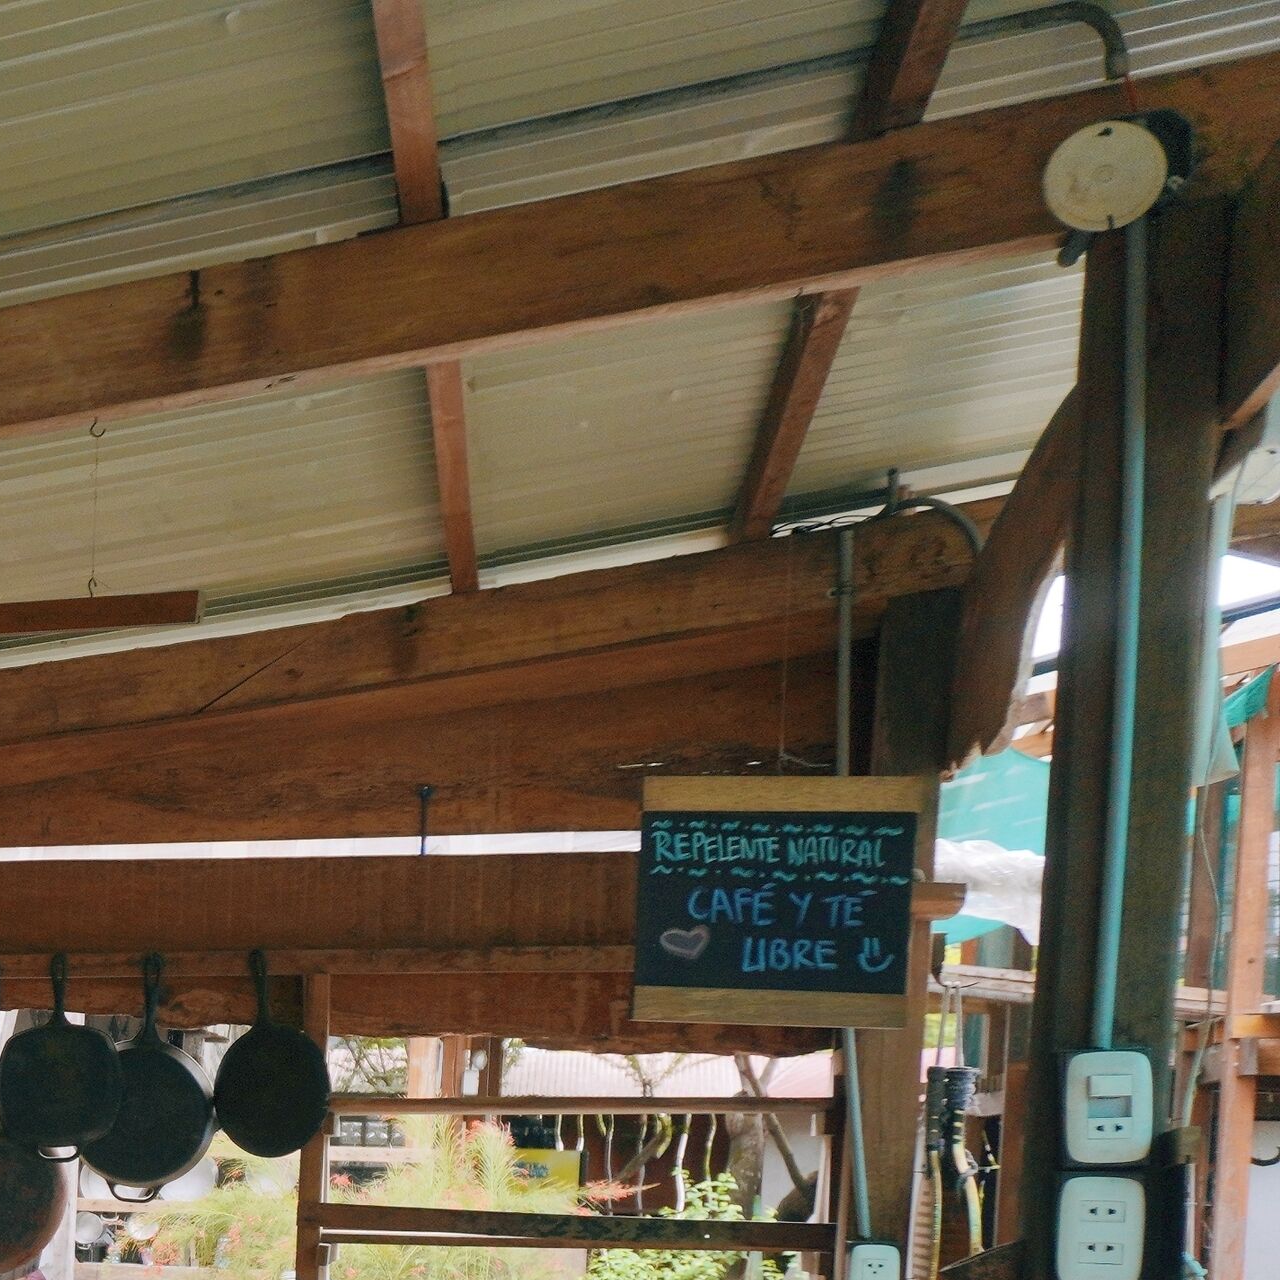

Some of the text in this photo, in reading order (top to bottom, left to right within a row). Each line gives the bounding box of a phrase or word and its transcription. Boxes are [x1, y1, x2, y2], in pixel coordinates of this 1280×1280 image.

[651, 831, 886, 868] REPELENTE NATURAL
[688, 883, 878, 928] CAFÉ Y TÉ
[742, 937, 839, 973] LIBRE
